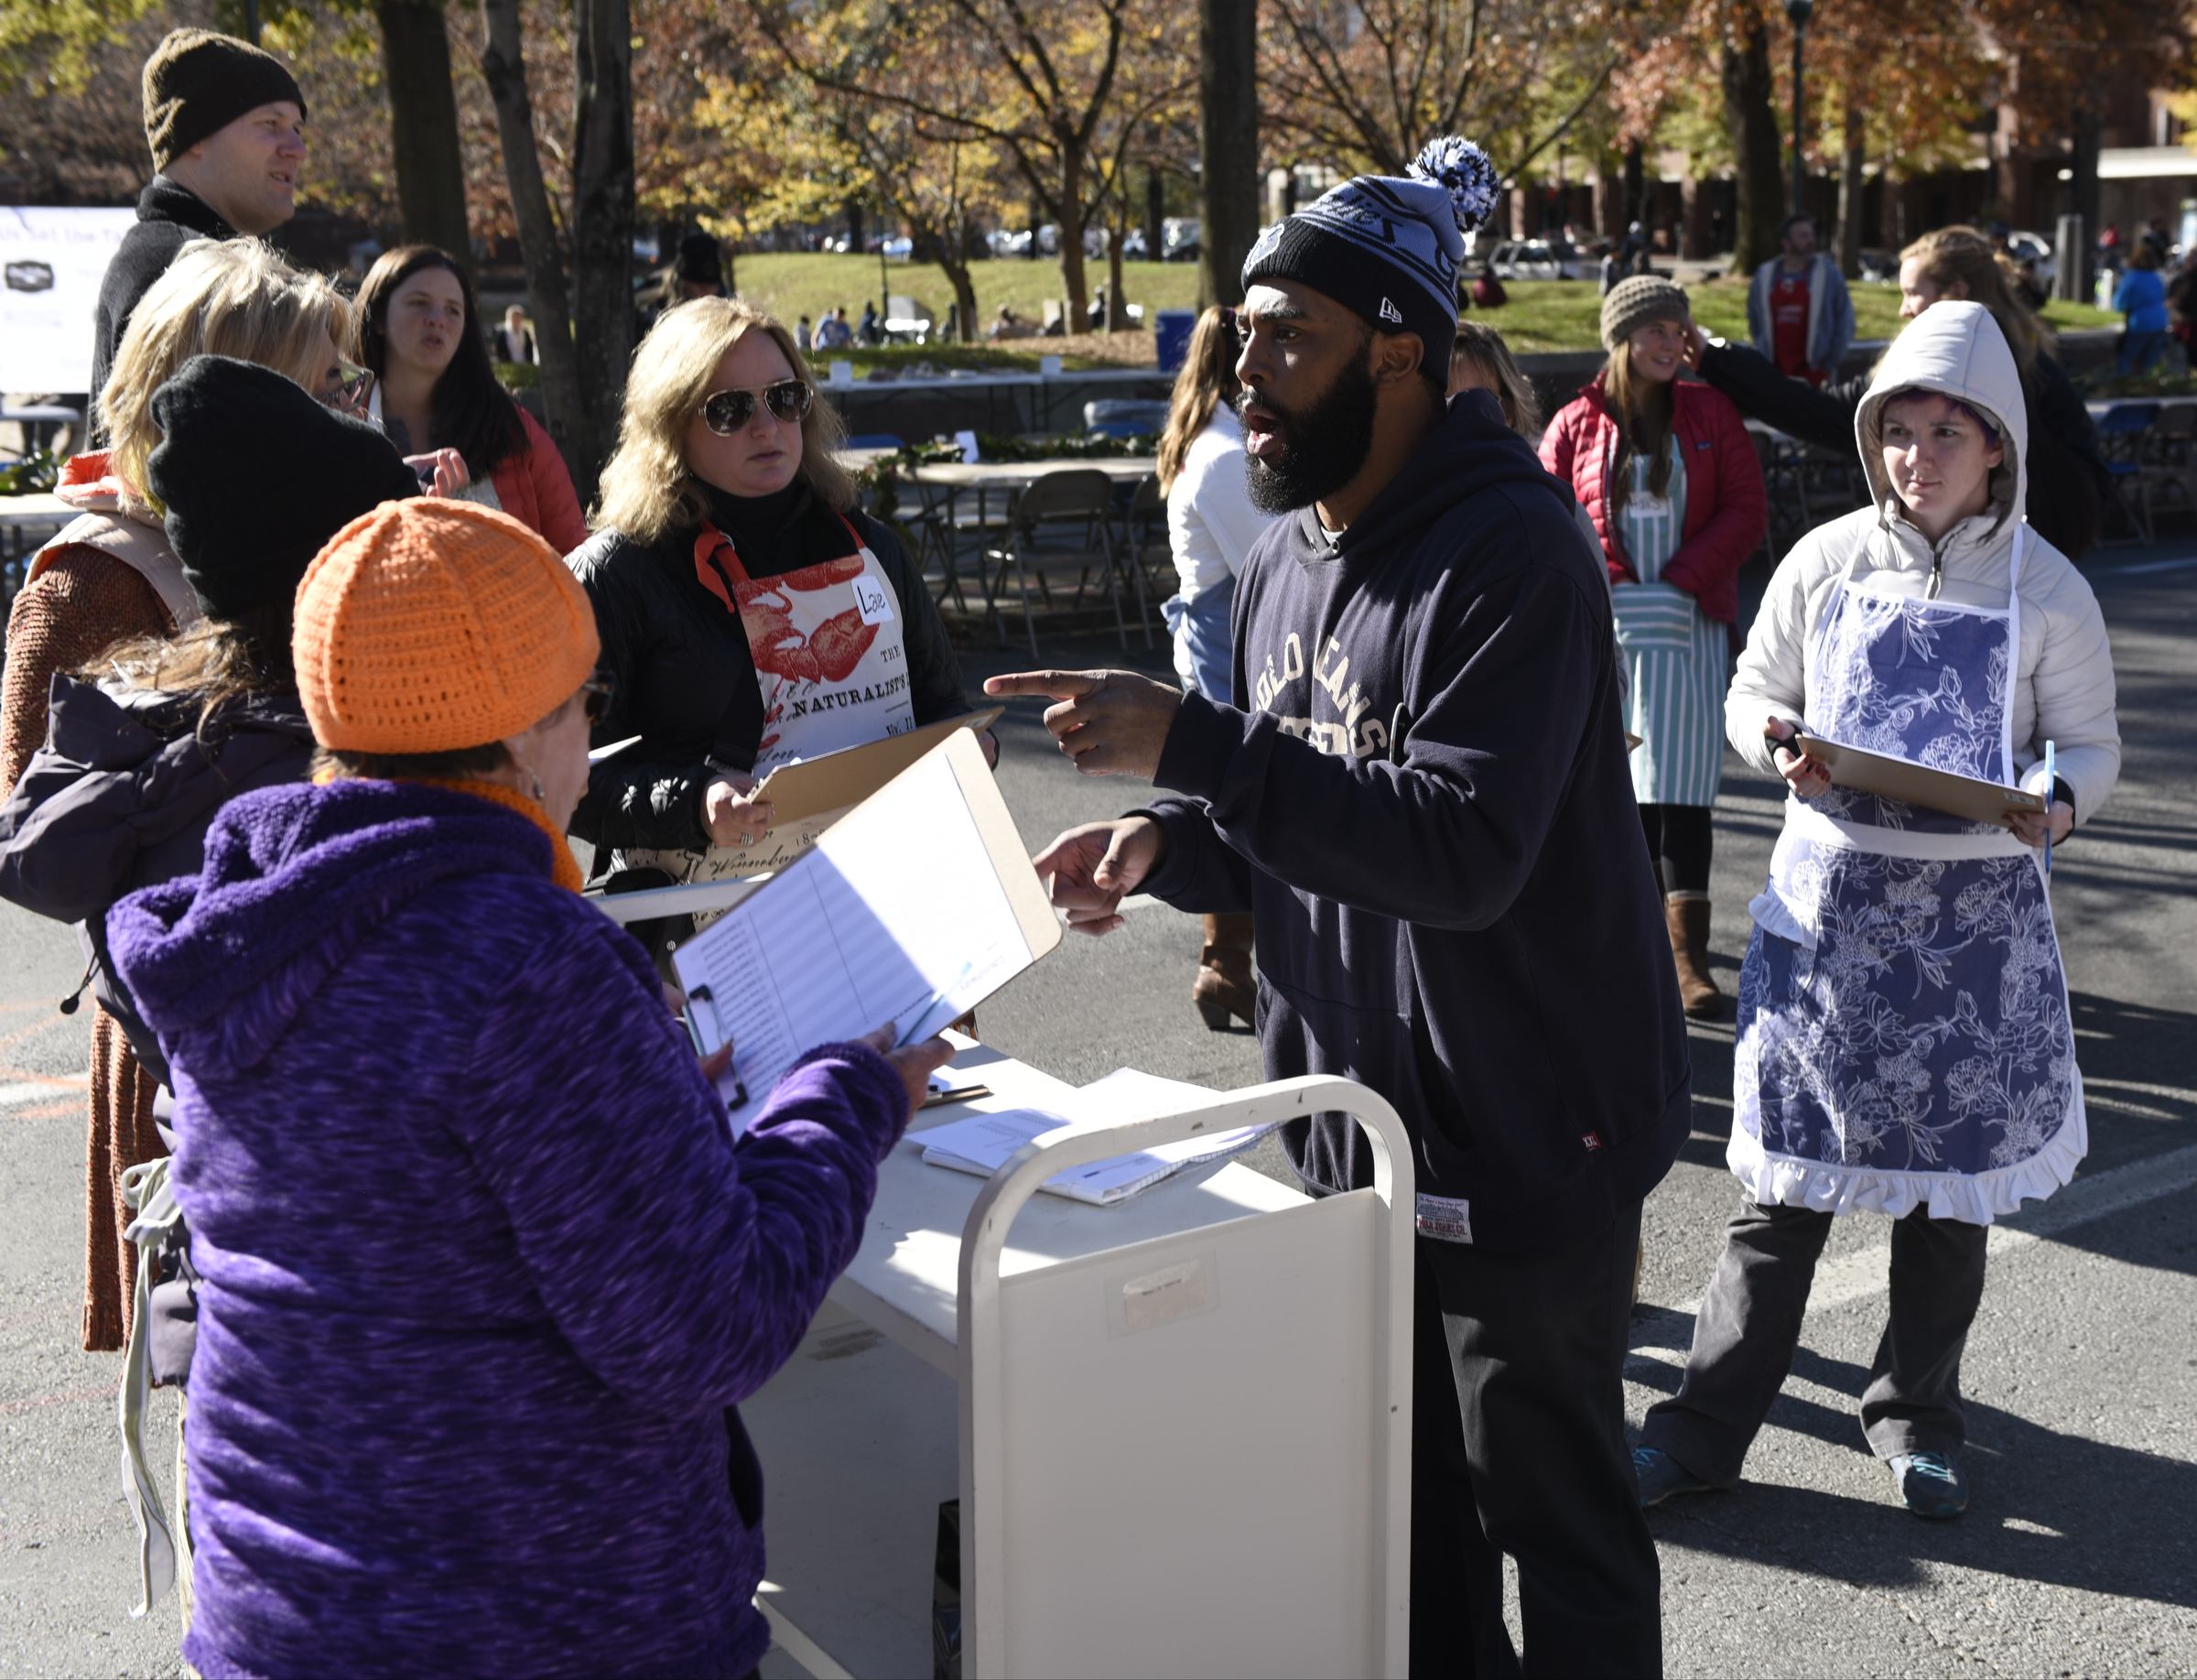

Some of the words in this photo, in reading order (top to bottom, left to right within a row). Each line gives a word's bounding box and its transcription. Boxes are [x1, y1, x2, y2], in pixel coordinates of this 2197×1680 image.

[881, 645, 901, 663] THE
[1256, 632, 1304, 711] OLO
[1313, 629, 1388, 759] EANS
[1582, 1134, 1597, 1148] XXL
